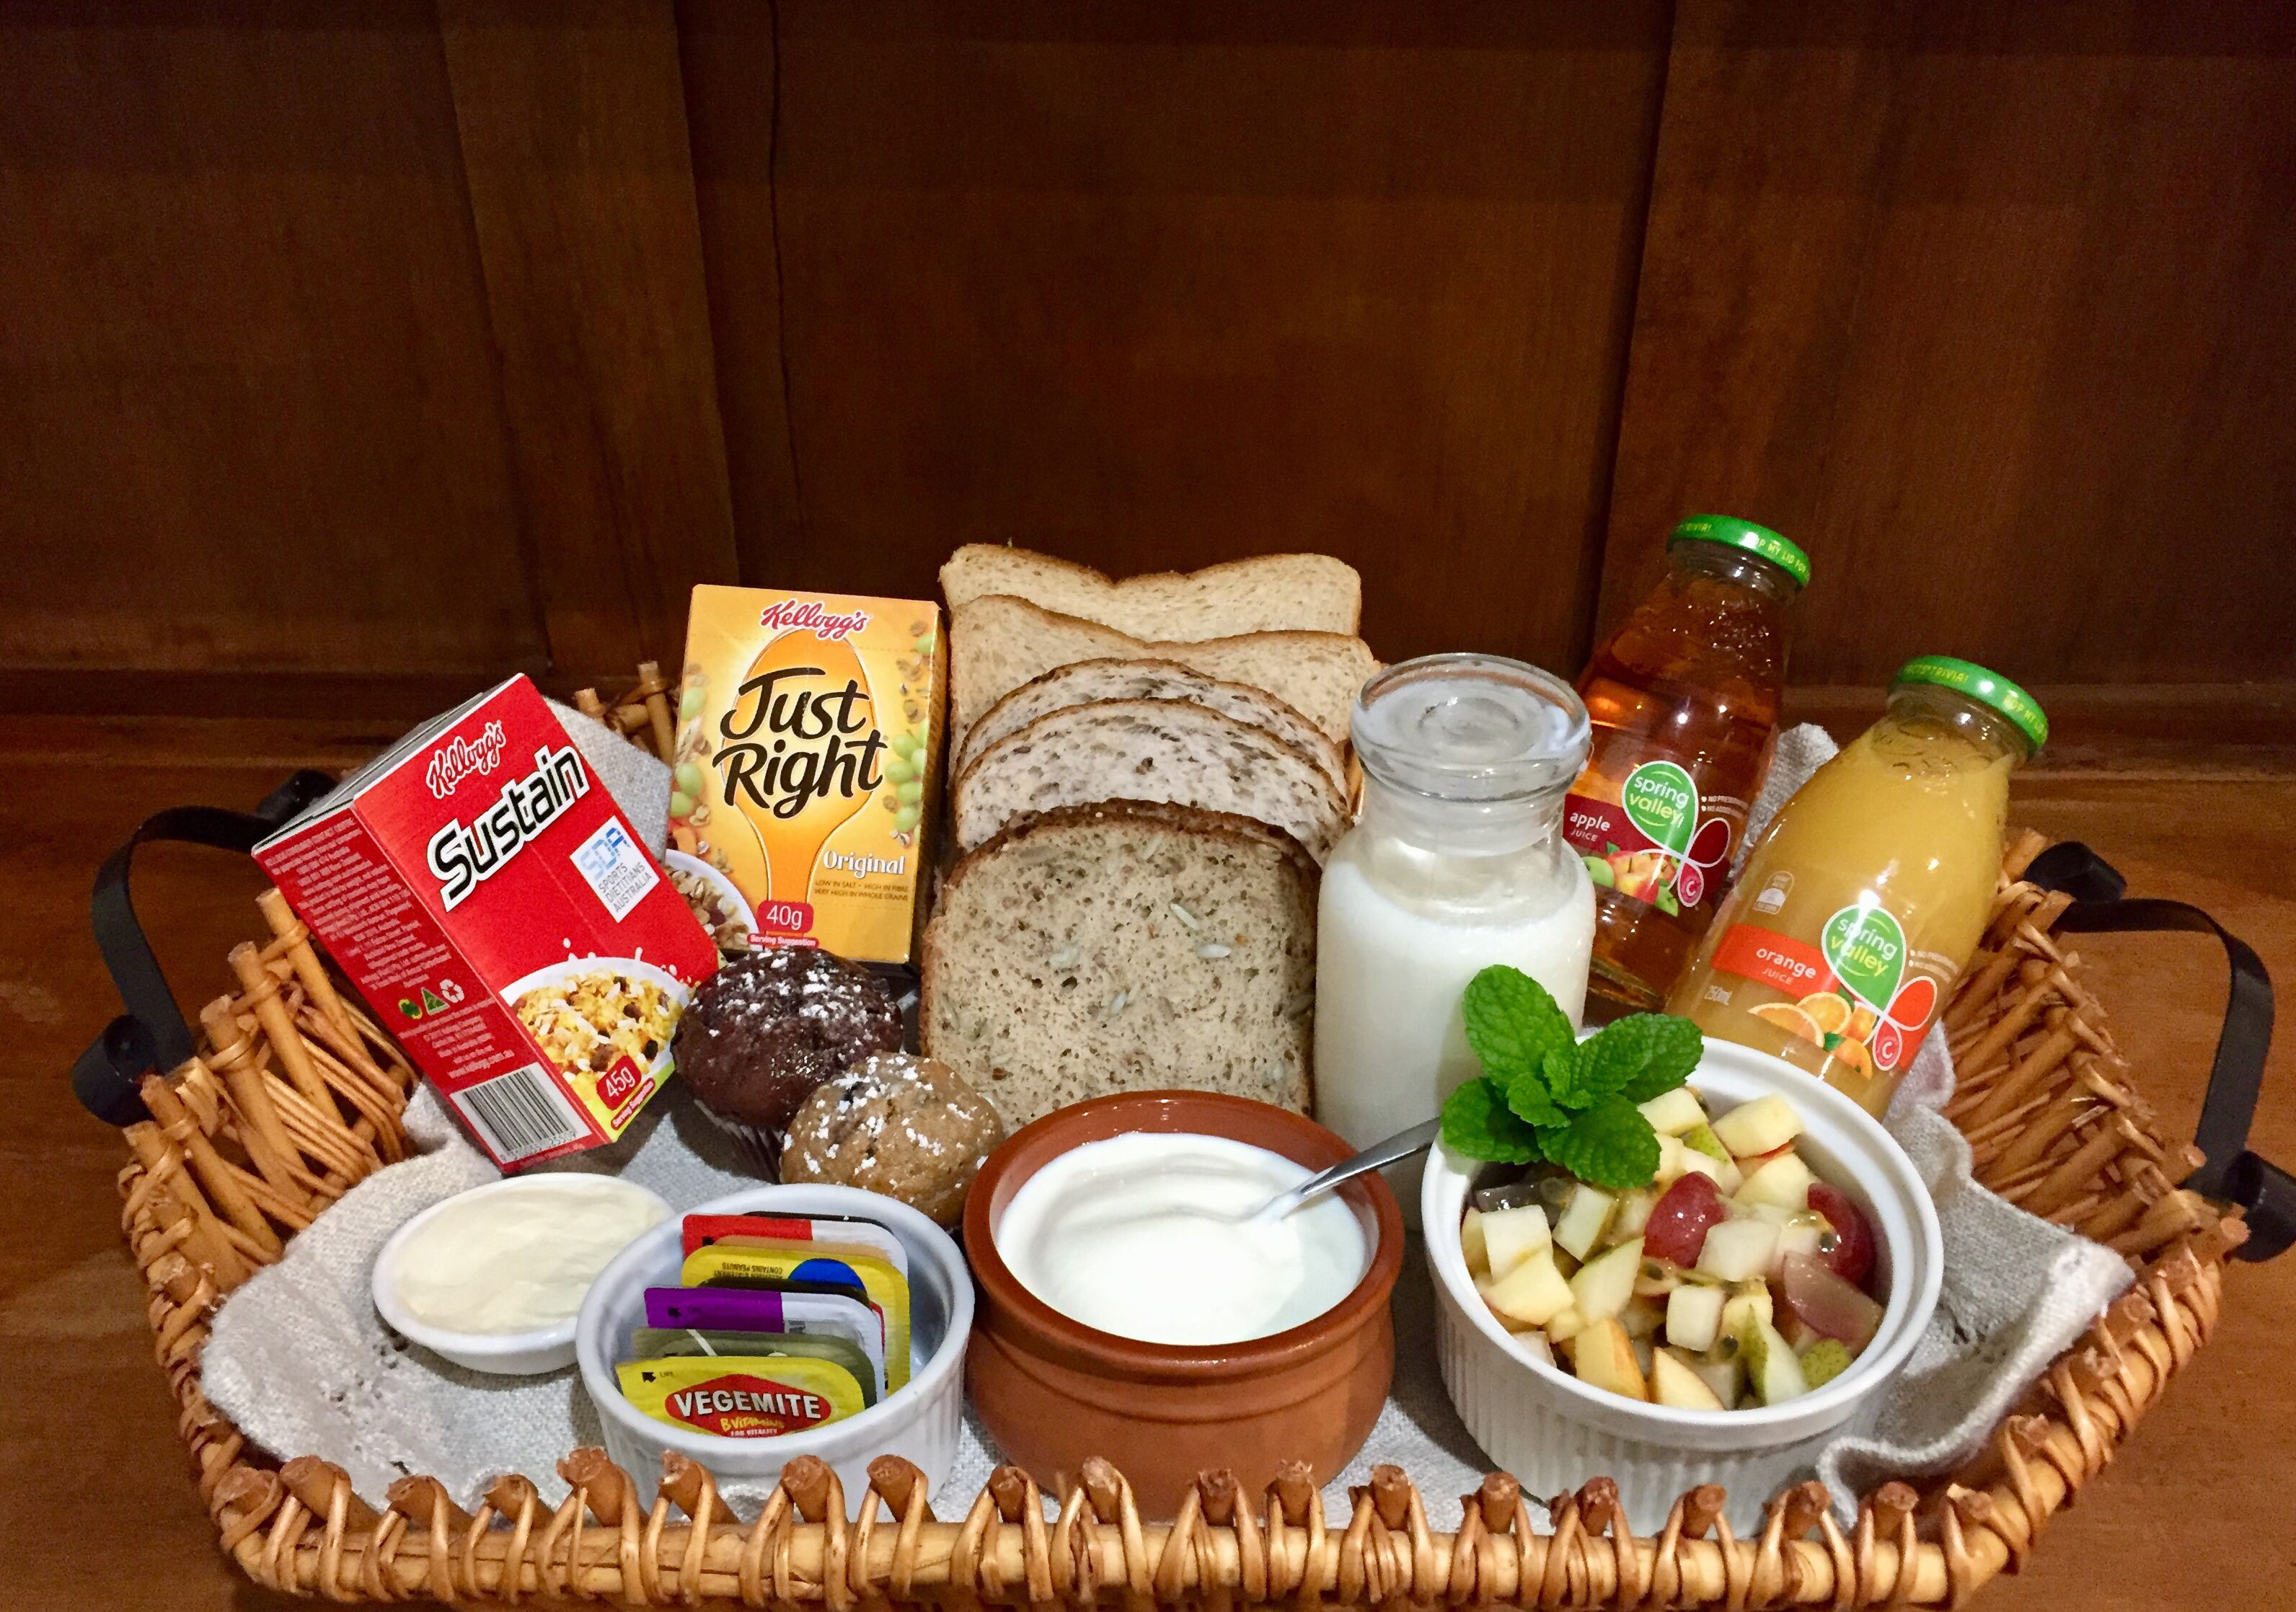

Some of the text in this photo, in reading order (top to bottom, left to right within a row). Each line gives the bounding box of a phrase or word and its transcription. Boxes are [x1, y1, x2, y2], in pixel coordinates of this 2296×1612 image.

[761, 600, 867, 639] Kellogg's
[720, 667, 870, 740] Just
[427, 721, 506, 798] Kellogg's
[712, 729, 888, 818] Right
[1629, 793, 1683, 826] valley
[1634, 776, 1689, 810] spring
[431, 748, 587, 906] Sustain
[1570, 812, 1611, 832] apple
[1570, 829, 1599, 842] JUICE
[599, 862, 628, 893] SPORTS
[824, 850, 906, 880] Original
[605, 862, 645, 903] DIETITIANS
[613, 872, 652, 913] AUSTRALIA
[766, 904, 803, 931] 40g
[1837, 918, 1897, 960] spring
[1755, 947, 1816, 979] orange
[1830, 935, 1889, 977] valley
[1762, 967, 1794, 986] JUICE
[606, 1066, 636, 1097] 45g
[674, 1390, 821, 1419] VEGEMITE
